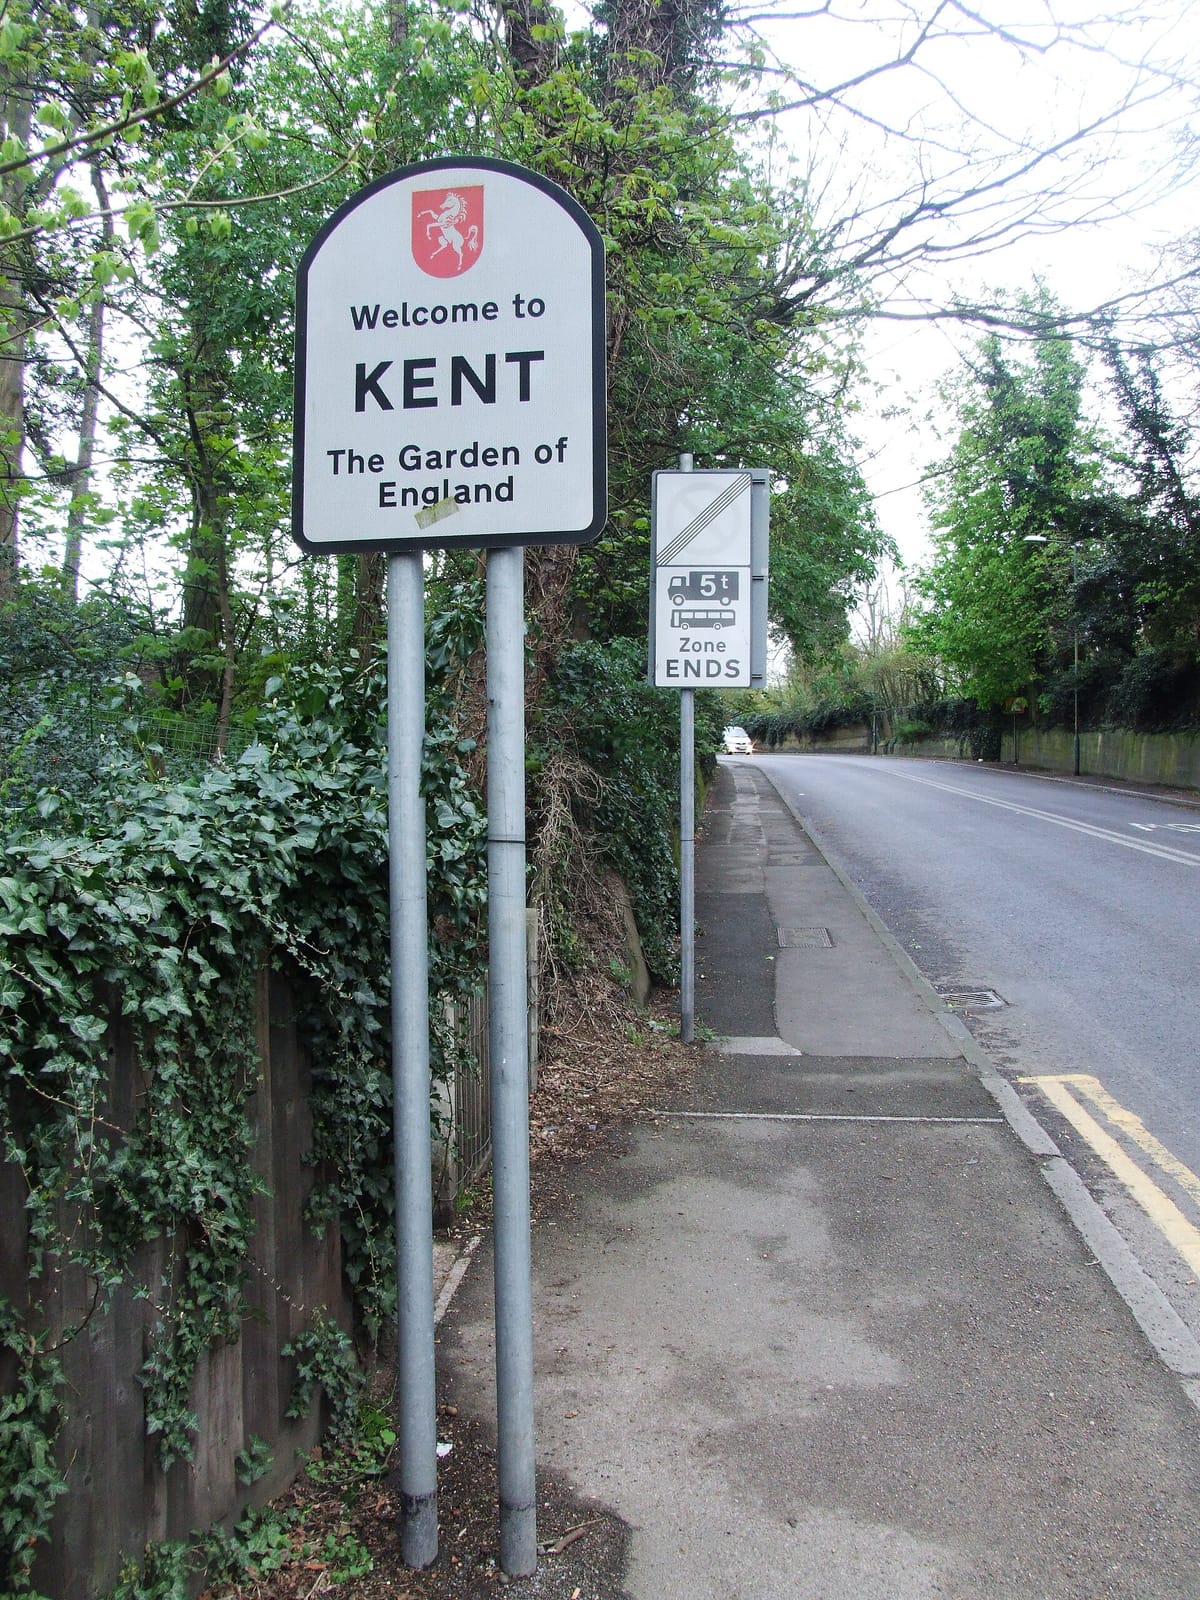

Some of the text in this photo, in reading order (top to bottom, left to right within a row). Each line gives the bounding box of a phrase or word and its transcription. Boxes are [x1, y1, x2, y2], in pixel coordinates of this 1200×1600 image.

[350, 293, 546, 330] Welcome to
[354, 350, 545, 413] KENT
[327, 437, 568, 475] The Garden of
[379, 475, 514, 510] England
[679, 637, 727, 653] Zone
[666, 659, 740, 678] ENDS
